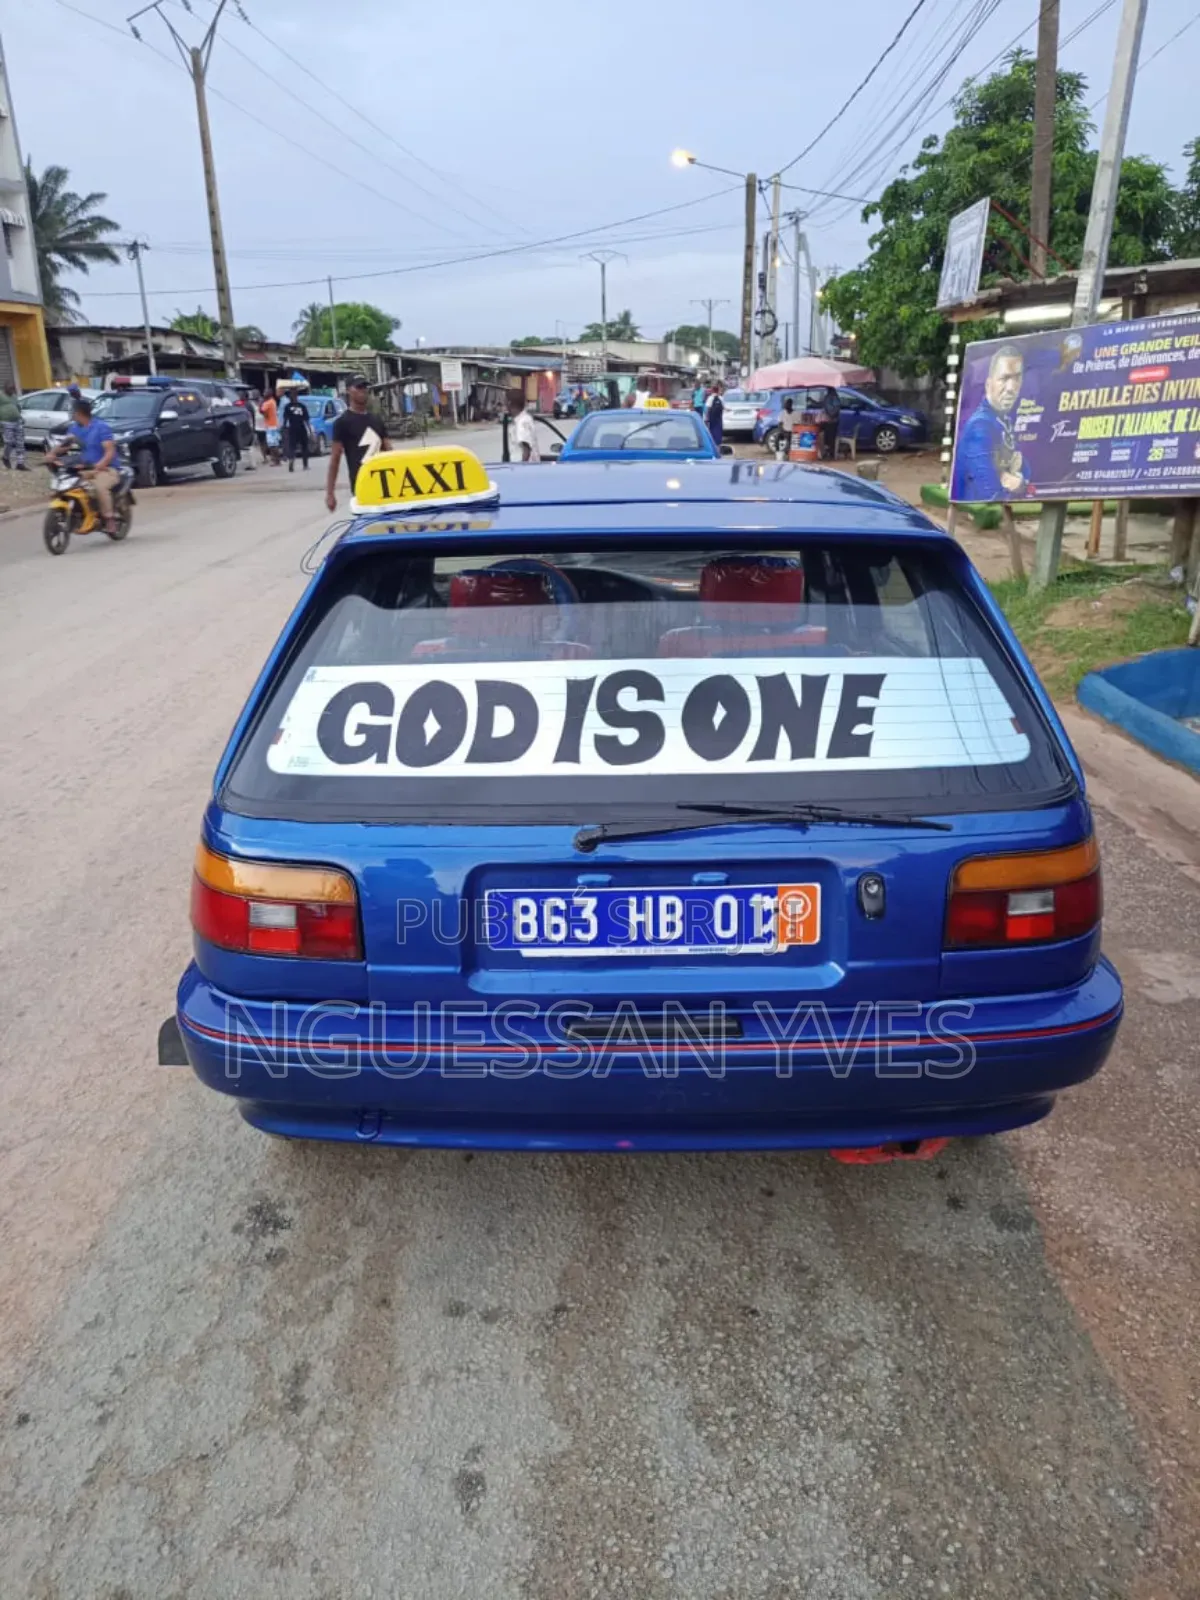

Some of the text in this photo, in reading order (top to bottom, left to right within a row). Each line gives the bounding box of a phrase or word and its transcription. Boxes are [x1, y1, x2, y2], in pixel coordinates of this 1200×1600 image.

[1095, 345, 1119, 359] UNE
[1121, 338, 1174, 356] GRANDE
[1119, 356, 1131, 369] de
[1058, 384, 1132, 412] BATAILLE
[1132, 382, 1162, 405] DES
[1173, 407, 1191, 433] DE
[370, 459, 468, 499] TAXI
[316, 669, 886, 768] GOD IS ONE
[512, 894, 599, 942] 863
[629, 893, 684, 943] HB
